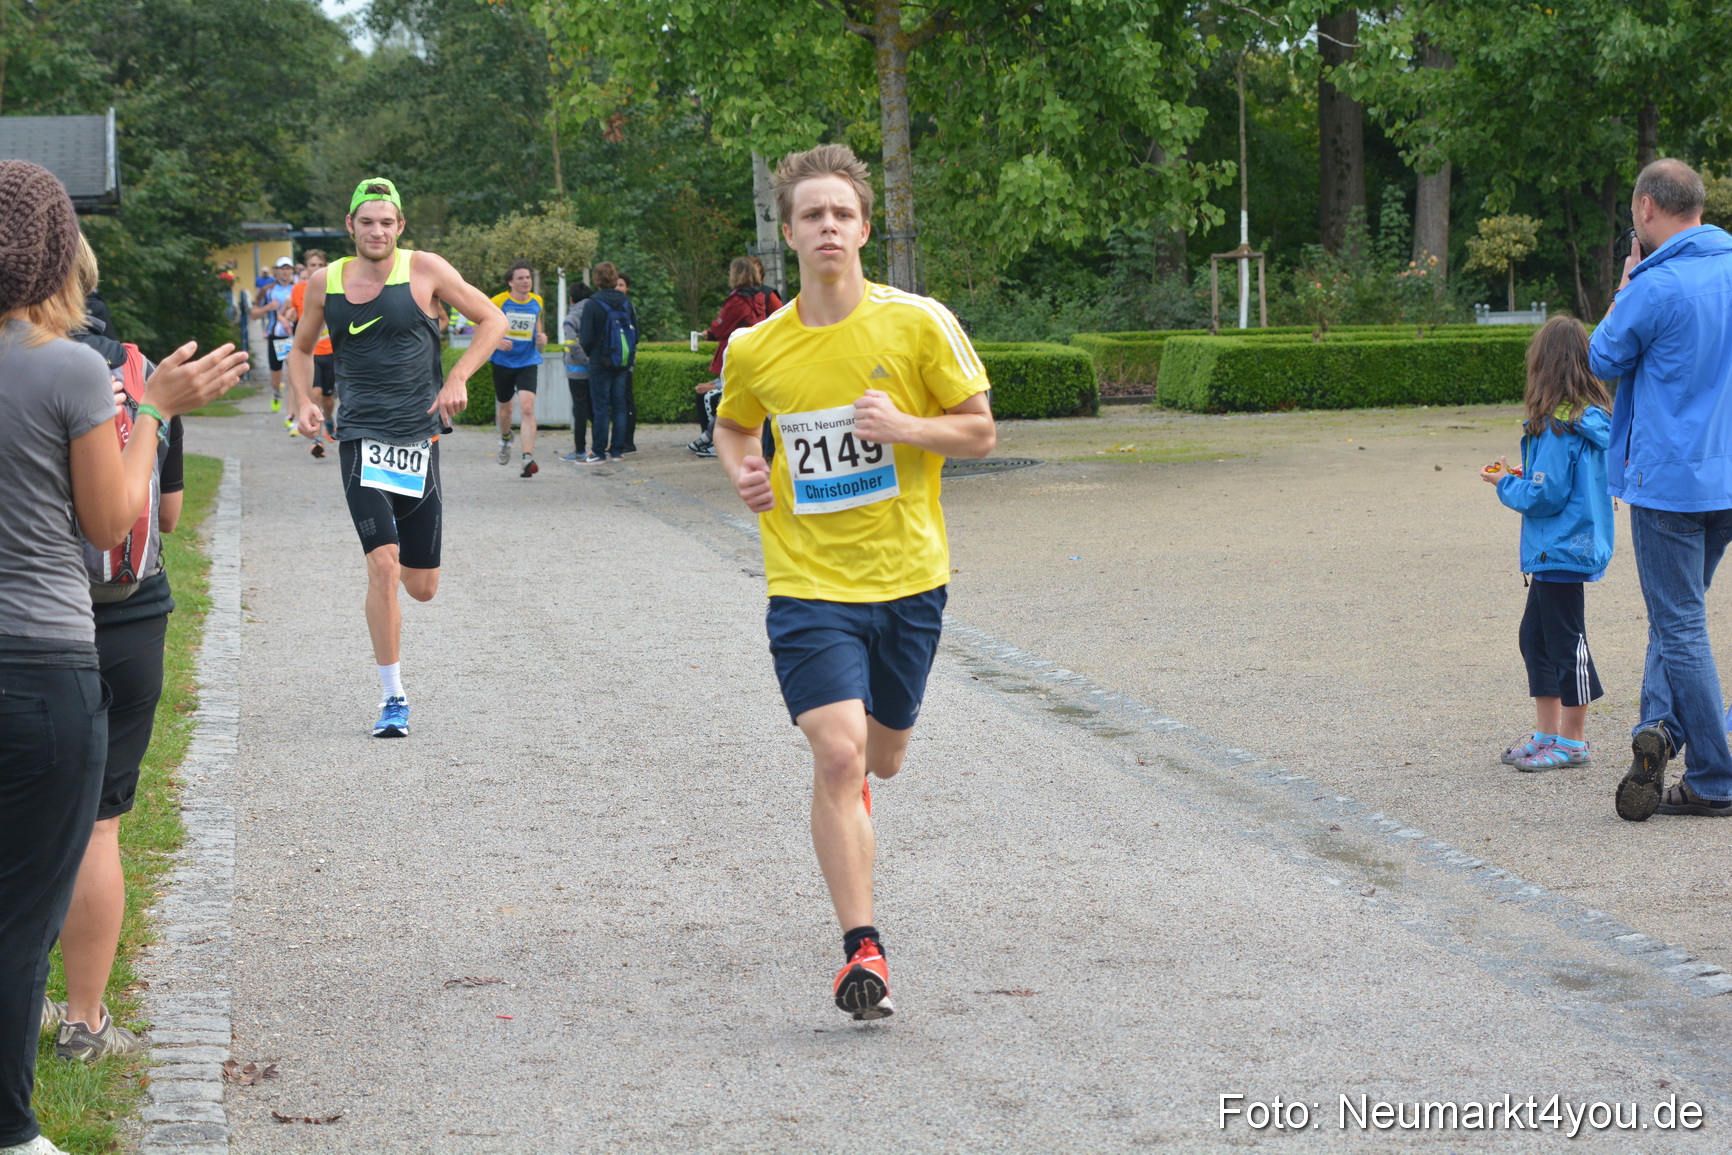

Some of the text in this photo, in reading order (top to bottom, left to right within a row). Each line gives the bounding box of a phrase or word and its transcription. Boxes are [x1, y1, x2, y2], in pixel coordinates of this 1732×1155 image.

[511, 320, 529, 330] 245
[781, 417, 856, 433] PARTL Neumar
[369, 444, 423, 472] 3400
[794, 432, 883, 474] 2149
[805, 475, 883, 499] Christopher
